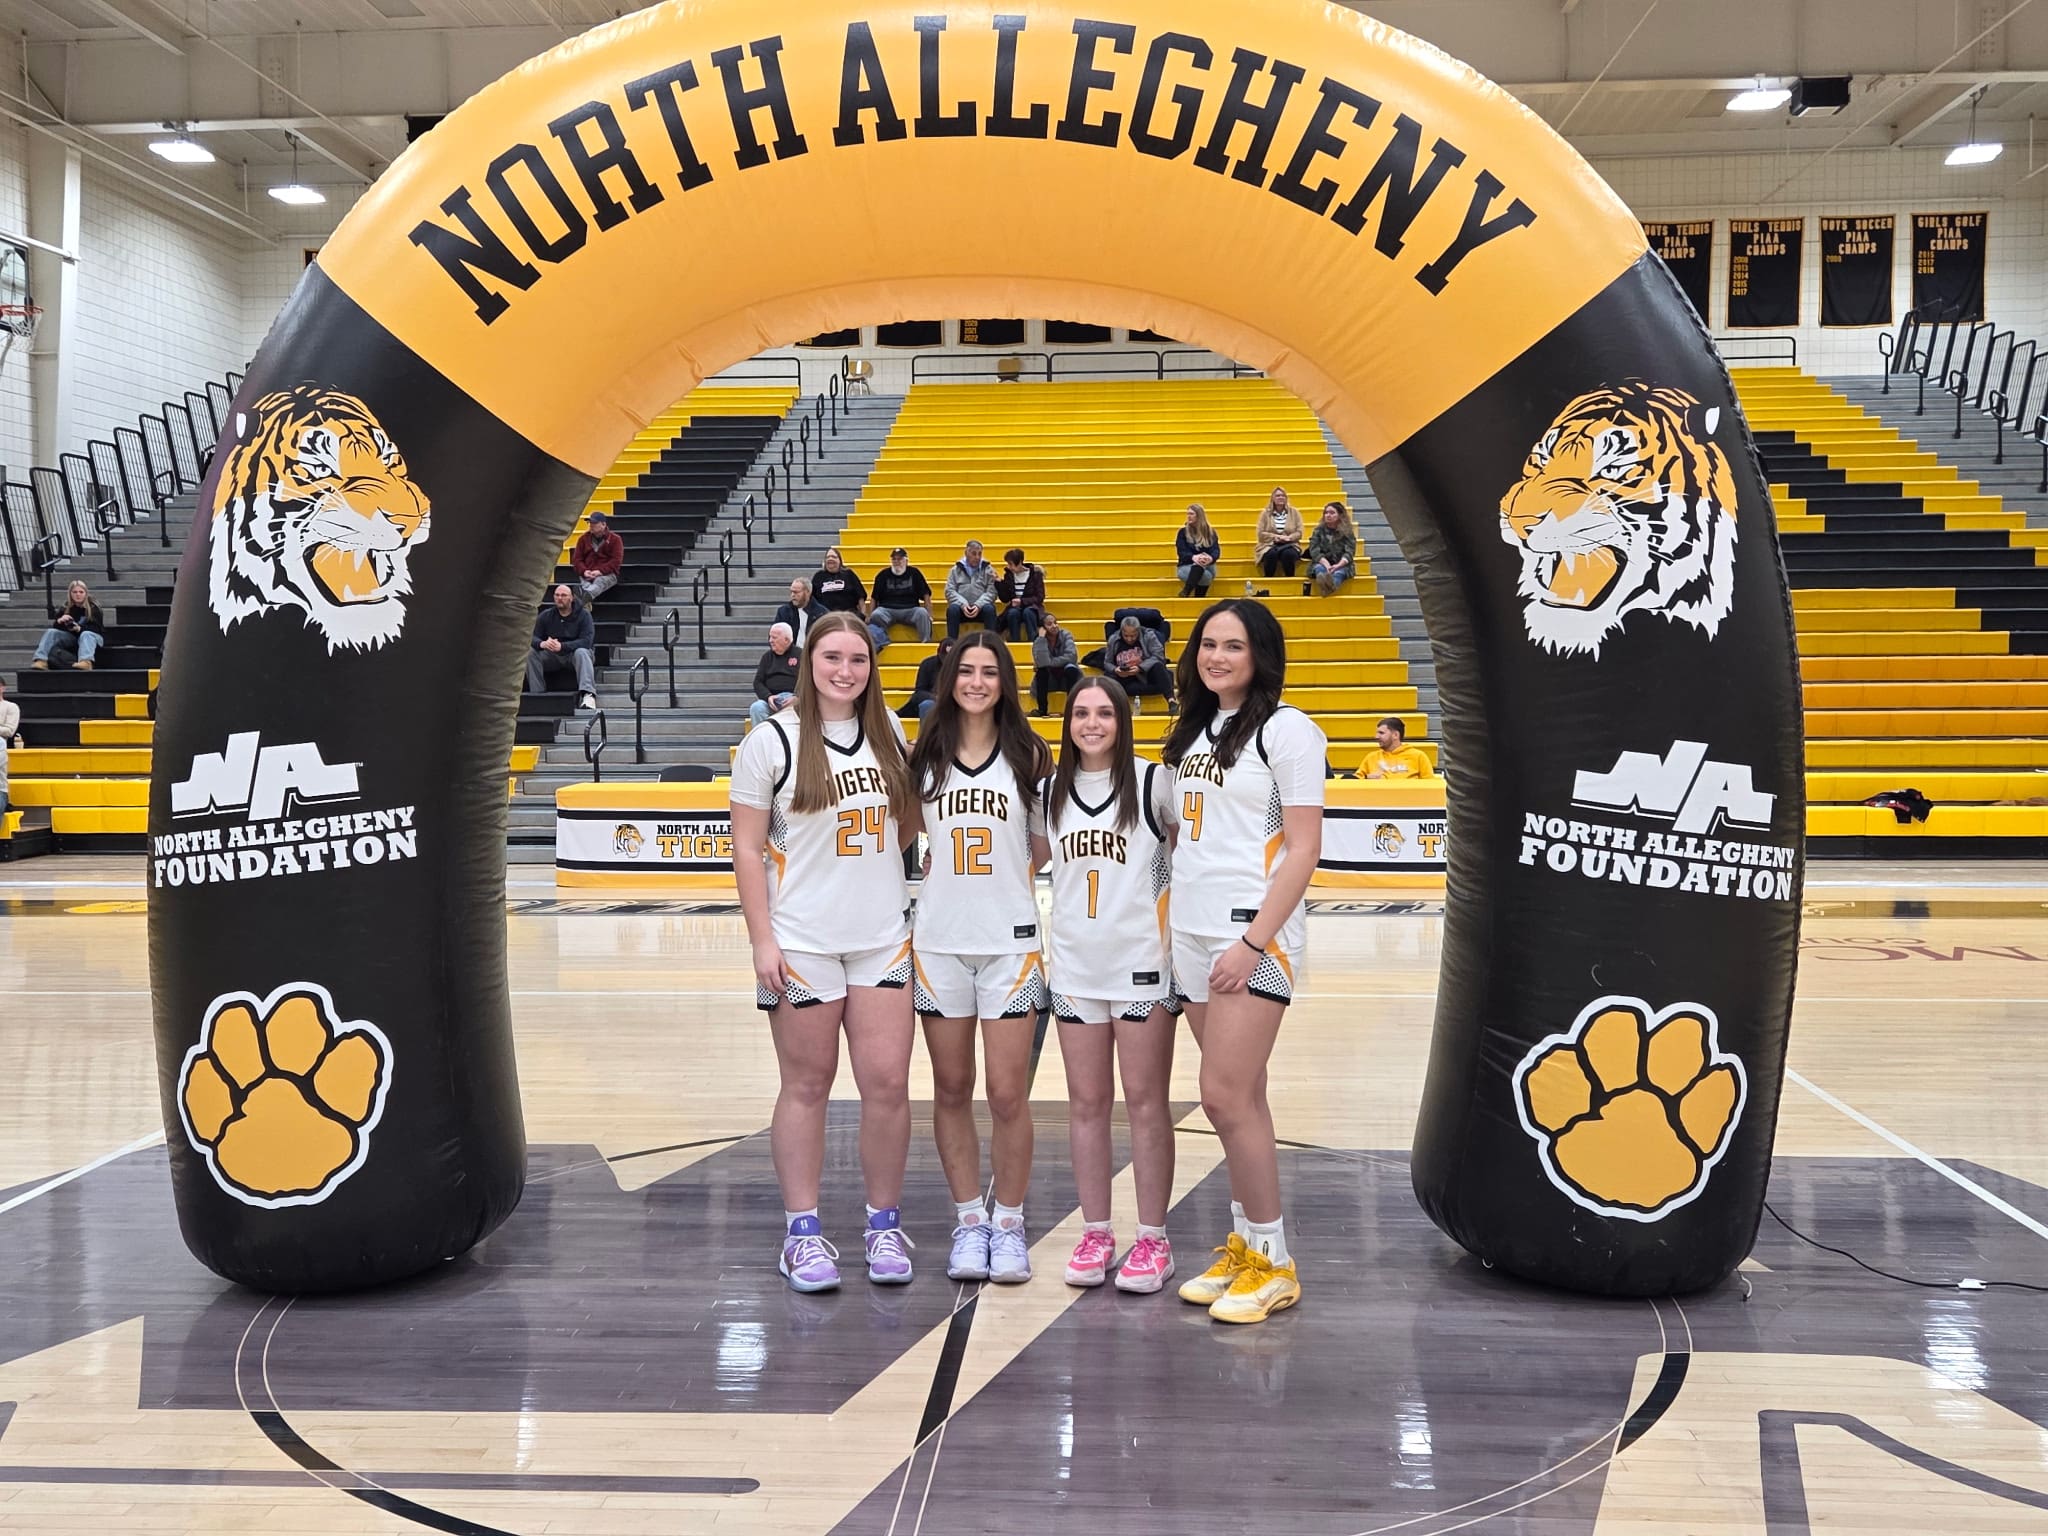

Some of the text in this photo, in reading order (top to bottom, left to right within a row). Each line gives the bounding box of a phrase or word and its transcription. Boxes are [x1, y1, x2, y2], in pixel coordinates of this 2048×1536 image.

[408, 15, 1537, 326] NORTH ALLEGHENY
[1676, 223, 1710, 236] TENNIS
[1731, 220, 1802, 233] GIRLS TENNIS
[1822, 217, 1893, 231] BOYS SOCCER
[1917, 215, 1982, 228] GIRLS GOLF
[1937, 227, 1962, 238] PIAA
[1664, 236, 1688, 248] PIAA
[1746, 243, 1786, 256] CHAMPS
[1753, 232, 1780, 244] PIAA
[1838, 242, 1877, 255] CHAMPS
[1845, 231, 1870, 243] PIAA
[1929, 238, 1969, 251] CHAMPS
[1657, 247, 1696, 259] CHAMPS
[171, 730, 360, 821] NA
[835, 767, 889, 800] IGER
[1572, 739, 1774, 835] NA
[936, 788, 1009, 822] TIGERS
[1183, 791, 1204, 841] 4
[154, 805, 415, 857] NORTH ALLEGHENY
[656, 824, 700, 835] NORTH
[836, 804, 888, 857] 24
[1523, 812, 1795, 869] NORTH ALLEGHENY
[154, 829, 417, 888] FOUNDATION
[656, 835, 734, 858] TIGE
[951, 827, 993, 875] 12
[1059, 829, 1127, 865] TIGERS
[1519, 835, 1793, 901] FOUNDATION
[1086, 869, 1099, 919] 1
